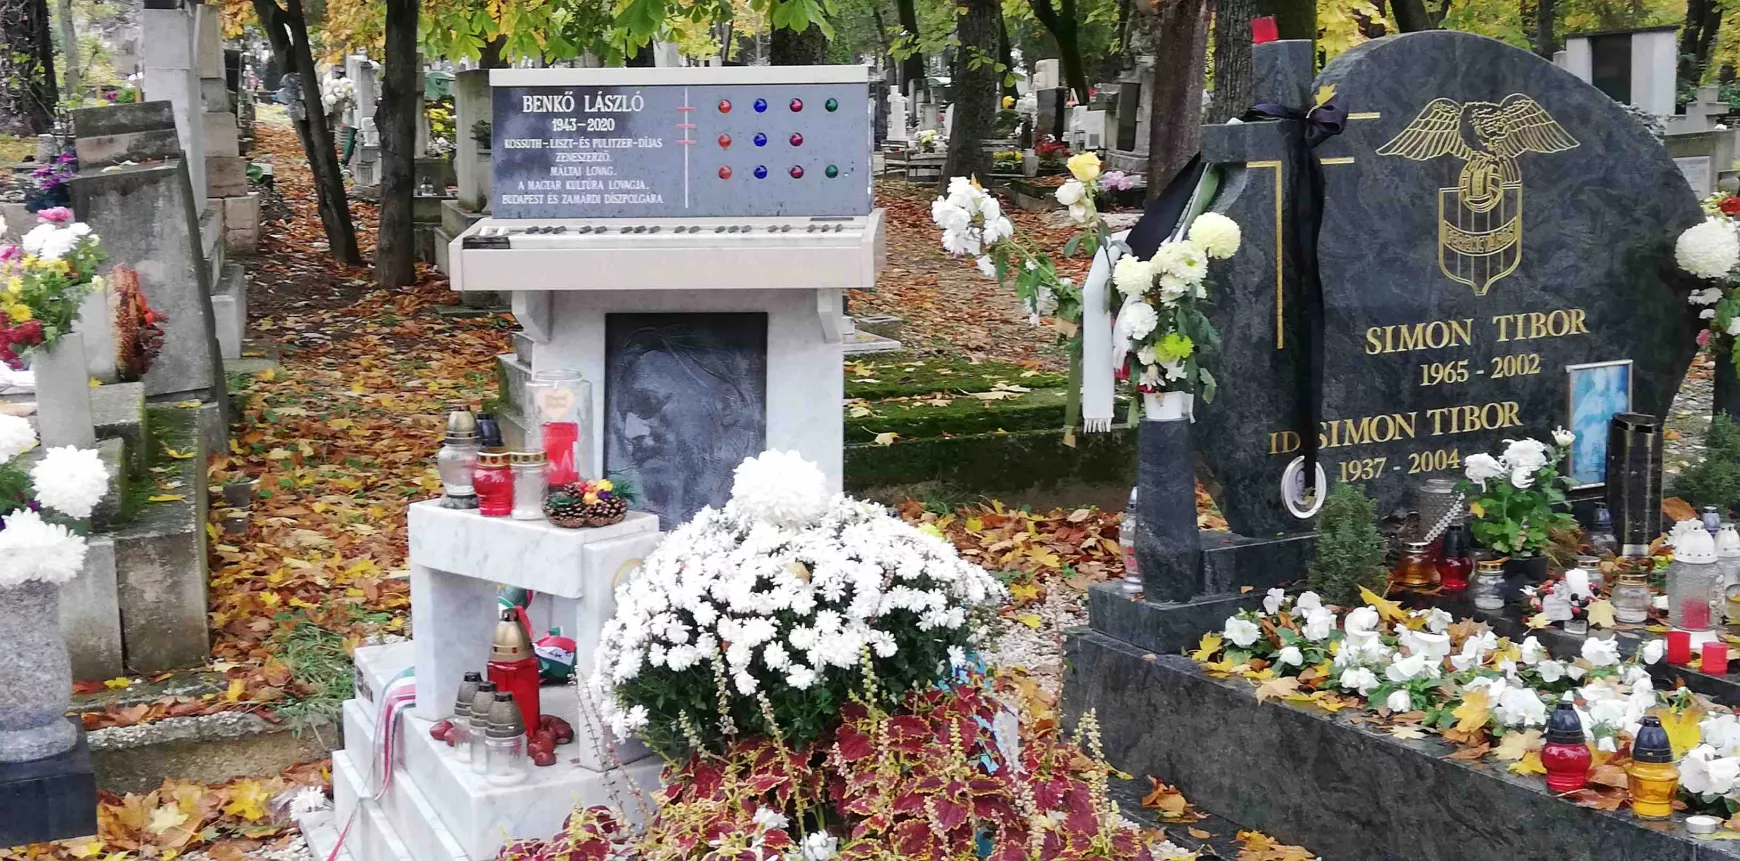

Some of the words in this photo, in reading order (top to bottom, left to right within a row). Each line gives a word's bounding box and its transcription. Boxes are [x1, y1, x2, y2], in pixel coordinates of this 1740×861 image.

[522, 91, 575, 113] BENKŐ
[584, 91, 645, 113] LÁSZLÓ
[518, 181, 525, 190] A
[527, 181, 562, 190] MAGYAR
[565, 178, 604, 190] KULTÚRA
[550, 164, 582, 177] MÁLTAI
[502, 194, 544, 204] BUDAPEST
[547, 192, 559, 204] ÉS
[561, 191, 601, 204] ZAMÁRDI
[1365, 318, 1474, 355] SIMON
[1493, 308, 1590, 342] TIBOR
[1420, 359, 1469, 387] 1965
[1490, 353, 1542, 379] 2002
[1318, 412, 1416, 450] SIMON
[1426, 401, 1523, 437] TIBOR
[1339, 457, 1387, 483] 1937
[1407, 449, 1460, 475] 2004
